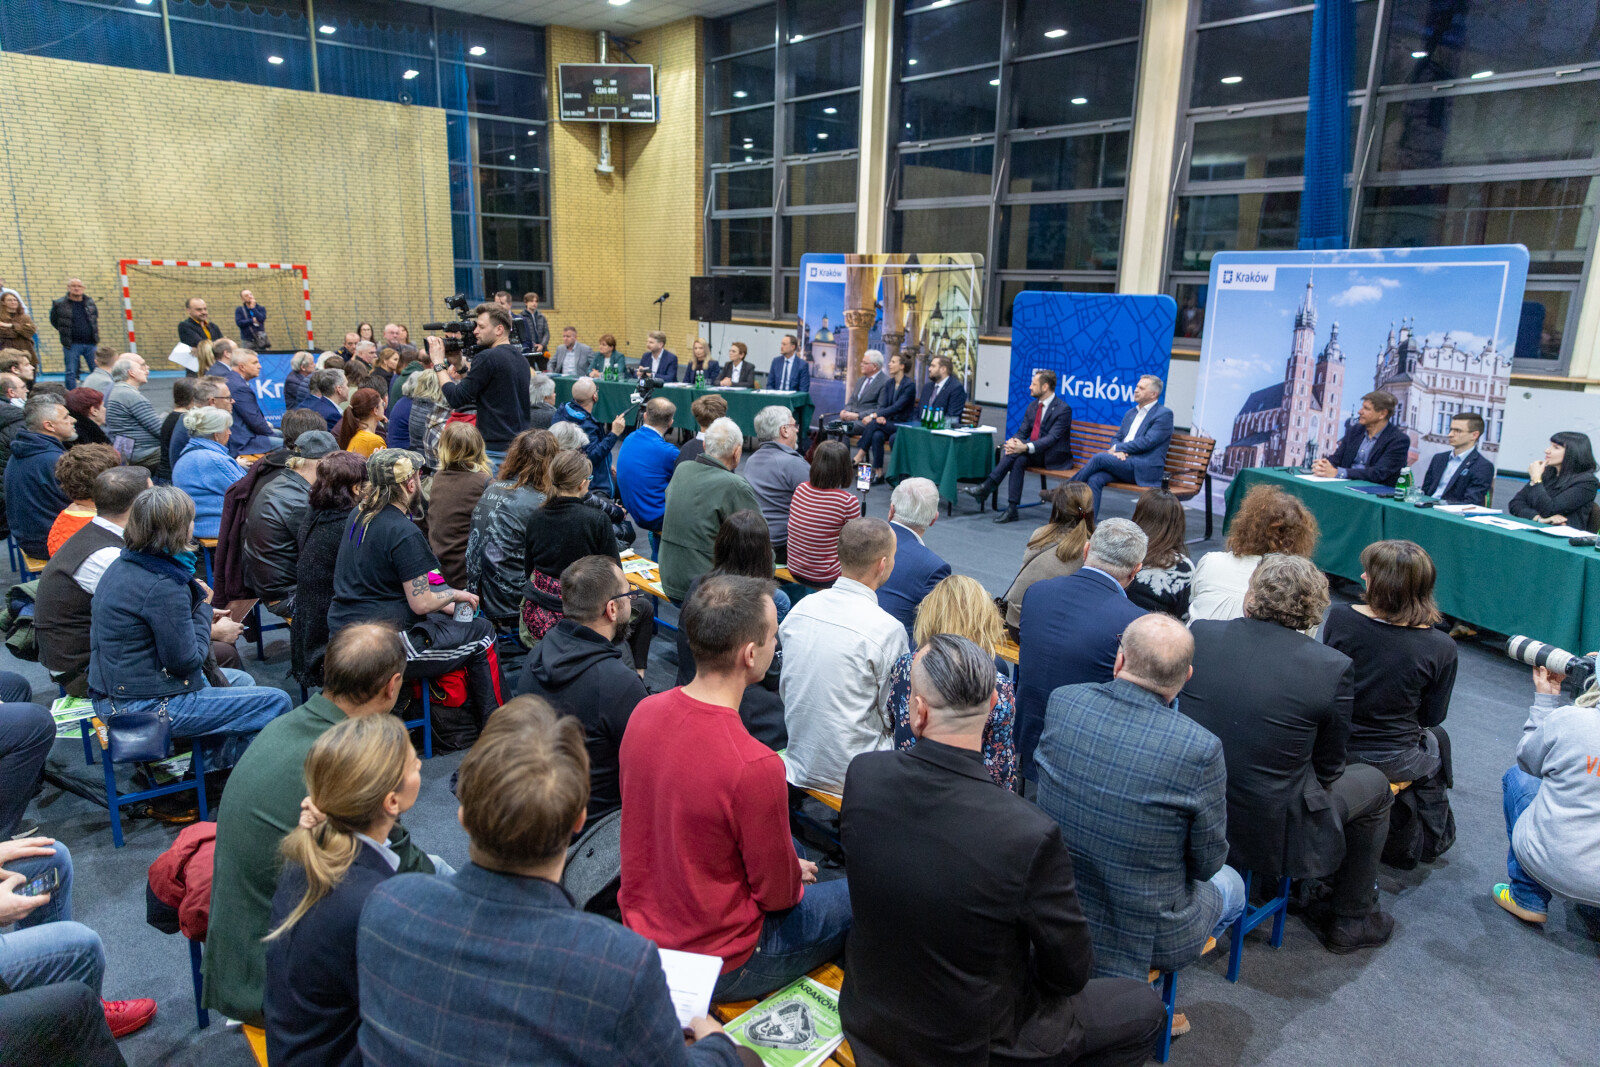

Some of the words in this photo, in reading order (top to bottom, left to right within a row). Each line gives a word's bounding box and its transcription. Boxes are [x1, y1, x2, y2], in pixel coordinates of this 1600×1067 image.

[819, 268, 842, 277] Kraków
[1235, 271, 1269, 283] Kraków
[1061, 374, 1135, 402] Kraków
